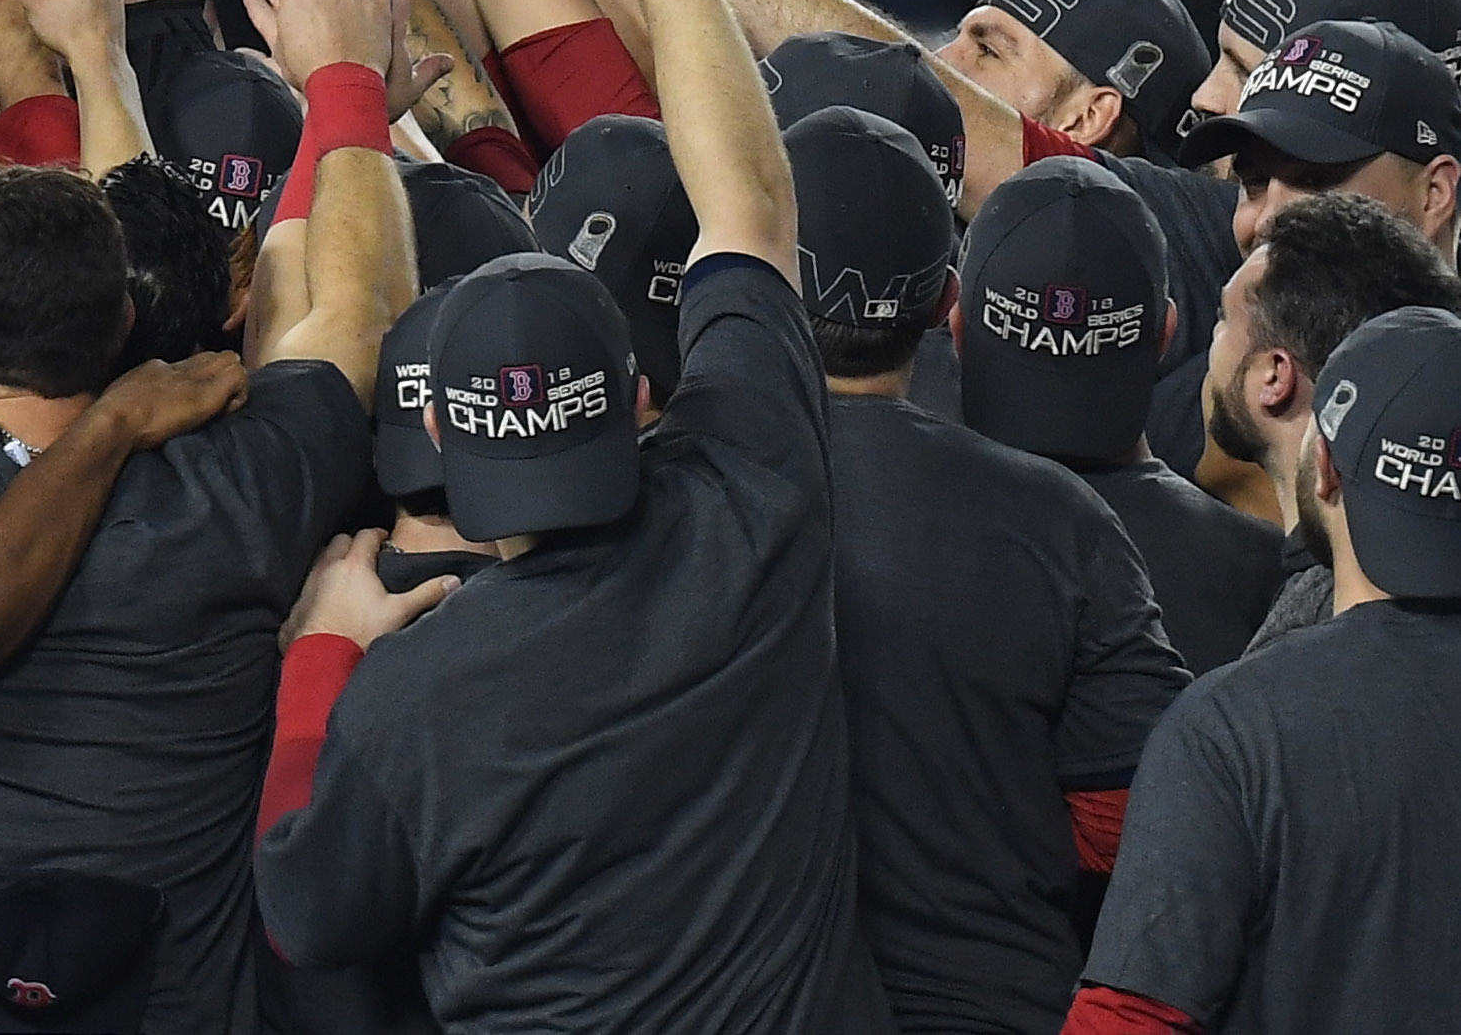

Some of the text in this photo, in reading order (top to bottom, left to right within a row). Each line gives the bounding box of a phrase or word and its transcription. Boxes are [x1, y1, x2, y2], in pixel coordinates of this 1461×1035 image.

[1320, 50, 1343, 63] 18
[1309, 59, 1370, 89] SERIES
[930, 144, 949, 158] 20
[189, 158, 217, 174] 20
[986, 287, 1143, 327] WORLD SERIES
[1014, 287, 1039, 304] 20
[1091, 298, 1113, 310] 18
[983, 304, 1141, 355] CHAMPS
[445, 371, 605, 407] WORLD SERIES
[471, 377, 495, 390] 20
[547, 367, 571, 384] 18
[448, 387, 607, 438] CHAMPS
[1381, 438, 1443, 466] WORLD
[1418, 435, 1445, 450] 20
